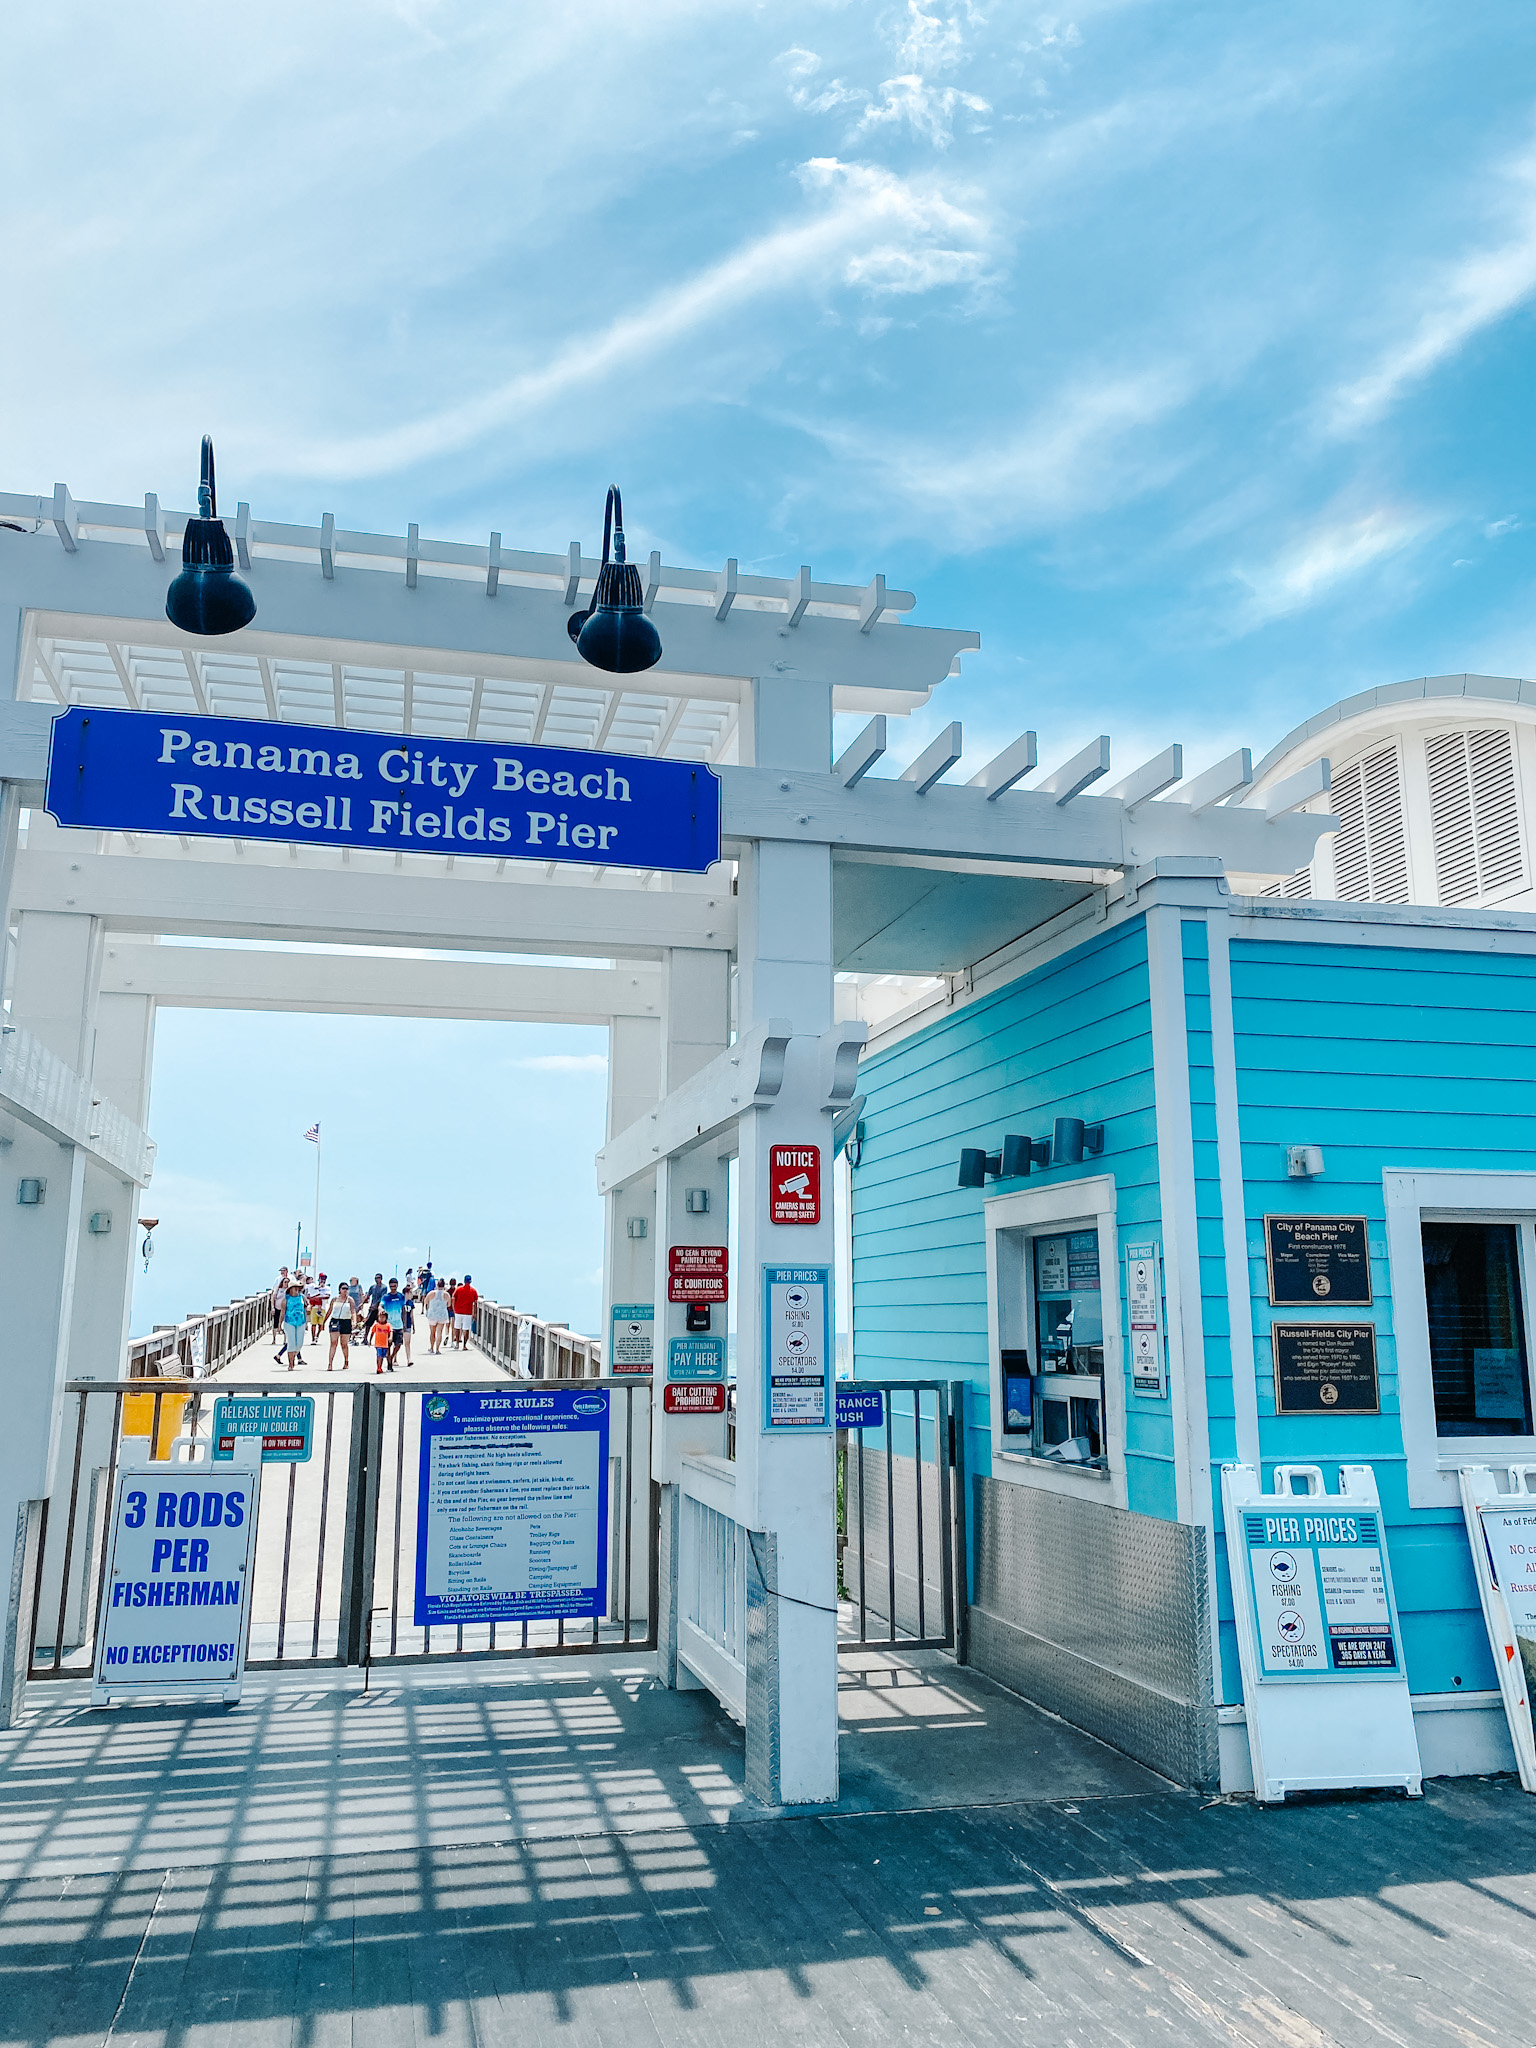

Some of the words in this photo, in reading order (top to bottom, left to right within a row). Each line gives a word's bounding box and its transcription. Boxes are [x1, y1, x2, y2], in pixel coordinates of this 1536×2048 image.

[157, 728, 362, 779] Panama
[378, 750, 478, 798] City
[493, 757, 632, 802] Beach
[169, 783, 353, 832] Russell
[369, 800, 512, 843] Fields
[527, 811, 618, 850] Pier
[776, 1151, 814, 1167] NOTICE
[775, 1201, 798, 1210] CAMERAS
[799, 1202, 805, 1210] IN
[806, 1202, 816, 1210] USE
[775, 1210, 785, 1219] FOR
[785, 1210, 798, 1219] YOUR
[799, 1210, 816, 1219] SAFETY
[1276, 1222, 1293, 1233] City
[1294, 1222, 1303, 1231] of
[1304, 1223, 1337, 1231] Panama
[1338, 1223, 1355, 1233] City
[1294, 1232, 1320, 1240] Beach
[1321, 1233, 1339, 1241] Pier
[675, 1249, 684, 1257] NO
[700, 1249, 722, 1257] BEYOND
[680, 1256, 704, 1264] PAINTED
[705, 1256, 717, 1264] LINE
[776, 1270, 792, 1281] PIER
[793, 1270, 818, 1281] PRICES
[674, 1278, 683, 1289] BE
[684, 1278, 723, 1289] COURTEOUS
[785, 1310, 810, 1320] FISHING
[1280, 1329, 1335, 1338] Russell-Fields
[1336, 1330, 1352, 1339] City
[1353, 1330, 1369, 1338] Pier
[676, 1342, 687, 1350] PIER
[674, 1352, 692, 1366] PAY
[695, 1352, 719, 1366] HERE
[778, 1356, 817, 1366] SPECTATORS
[672, 1387, 687, 1397] BAIT
[688, 1387, 718, 1397] CUTTING
[480, 1398, 512, 1409] PIER
[514, 1397, 554, 1409] RULES
[675, 1396, 714, 1406] PROHIBITED
[836, 1397, 879, 1408] RANCE
[221, 1405, 260, 1419] RELEASE
[263, 1405, 283, 1419] LIVE
[285, 1405, 306, 1418] FISH
[453, 1415, 460, 1423] To
[461, 1415, 491, 1423] maximize
[491, 1415, 505, 1423] your
[505, 1414, 543, 1422] recreational
[544, 1413, 580, 1422] experience,
[227, 1422, 238, 1433] OR
[239, 1422, 258, 1433] KEEP
[260, 1422, 268, 1432] IN
[270, 1421, 298, 1432] COOLER
[463, 1425, 484, 1433] please
[485, 1424, 509, 1432] observe
[510, 1423, 521, 1431] the
[521, 1423, 550, 1431] following
[221, 1439, 235, 1448] DON
[268, 1439, 276, 1447] ON
[277, 1438, 287, 1447] THE
[287, 1438, 302, 1447] PIER!
[124, 1491, 148, 1529] 3
[155, 1491, 245, 1529] RODS
[462, 1515, 492, 1523] following
[1503, 1518, 1512, 1526] As
[1514, 1517, 1521, 1526] of
[1265, 1517, 1301, 1543] PIER
[1303, 1517, 1359, 1543] PRICES
[1509, 1544, 1525, 1555] NO
[151, 1538, 210, 1573] PER
[112, 1580, 241, 1608] FISHERMAN
[439, 1593, 490, 1603] VIOLATORS
[490, 1592, 514, 1600] WILL
[514, 1591, 527, 1599] BE
[529, 1589, 583, 1599] TRESPASSED.
[1272, 1584, 1302, 1597] FISHING
[1280, 1597, 1296, 1607] $7.00
[1271, 1644, 1318, 1658] SPECTATORS
[1337, 1641, 1347, 1651] WE
[1347, 1641, 1358, 1651] ARE
[1358, 1641, 1372, 1650] OPEN
[1372, 1640, 1386, 1650] 24/7
[105, 1645, 129, 1665] NO
[132, 1643, 235, 1664] EXCEPTIONS!
[1341, 1650, 1352, 1660] 365
[1352, 1650, 1367, 1660] DAYS
[1367, 1650, 1372, 1659] A
[1372, 1650, 1387, 1659] YEAR
[1288, 1658, 1304, 1668] $4.00
